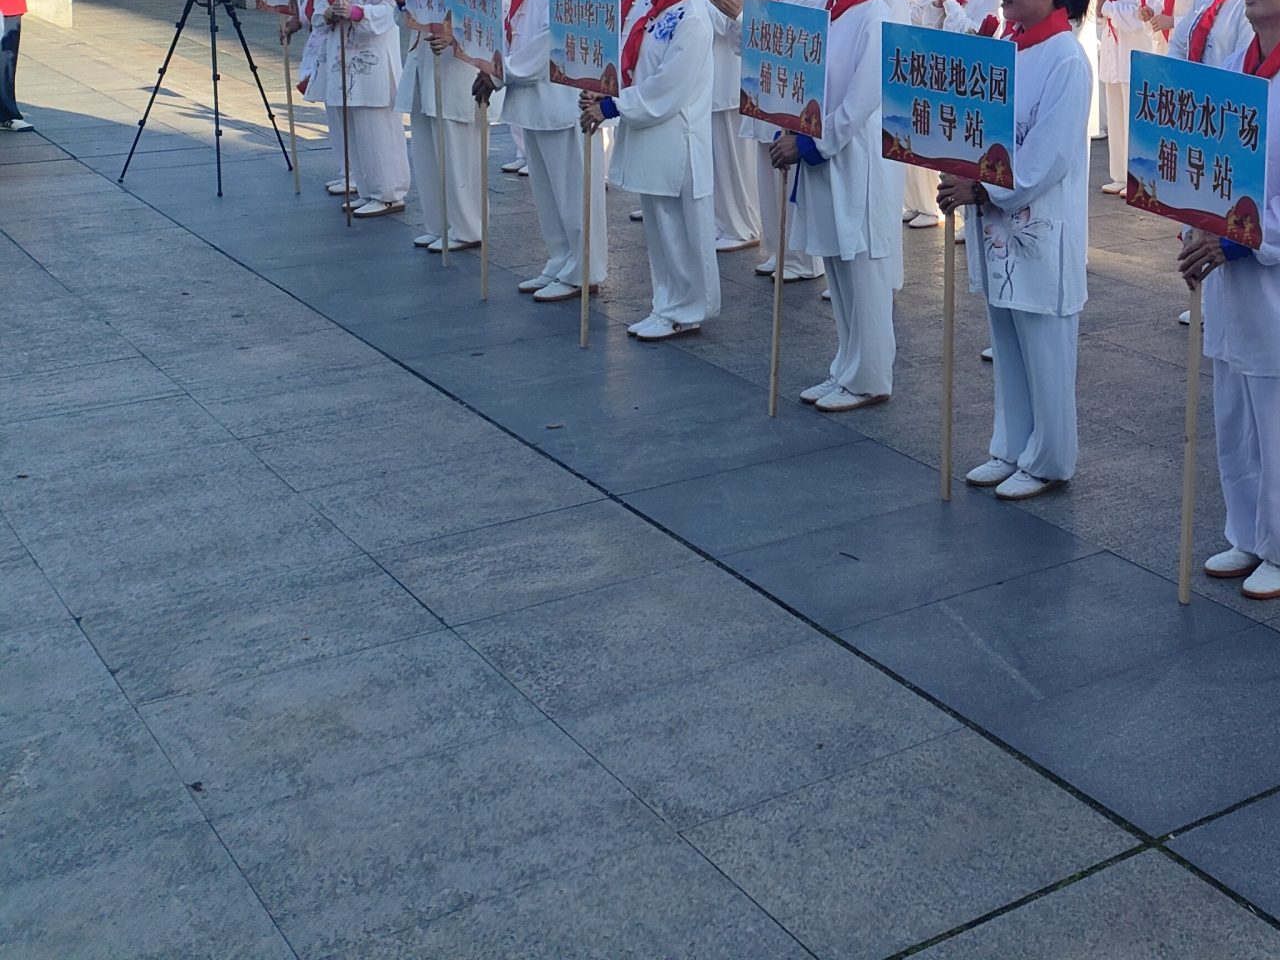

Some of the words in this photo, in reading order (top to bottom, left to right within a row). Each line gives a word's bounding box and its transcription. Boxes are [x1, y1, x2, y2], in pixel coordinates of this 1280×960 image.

[463, 15, 494, 53] 辅导站
[566, 32, 603, 68] 辅导站
[747, 18, 822, 65] 太极健身气功
[760, 61, 805, 104] 辅导站
[888, 48, 1008, 105] 太极湿地公园
[911, 97, 985, 149] 辅导站
[1136, 81, 1260, 153] 太极粉水广场
[1157, 138, 1233, 201] 辅导站
